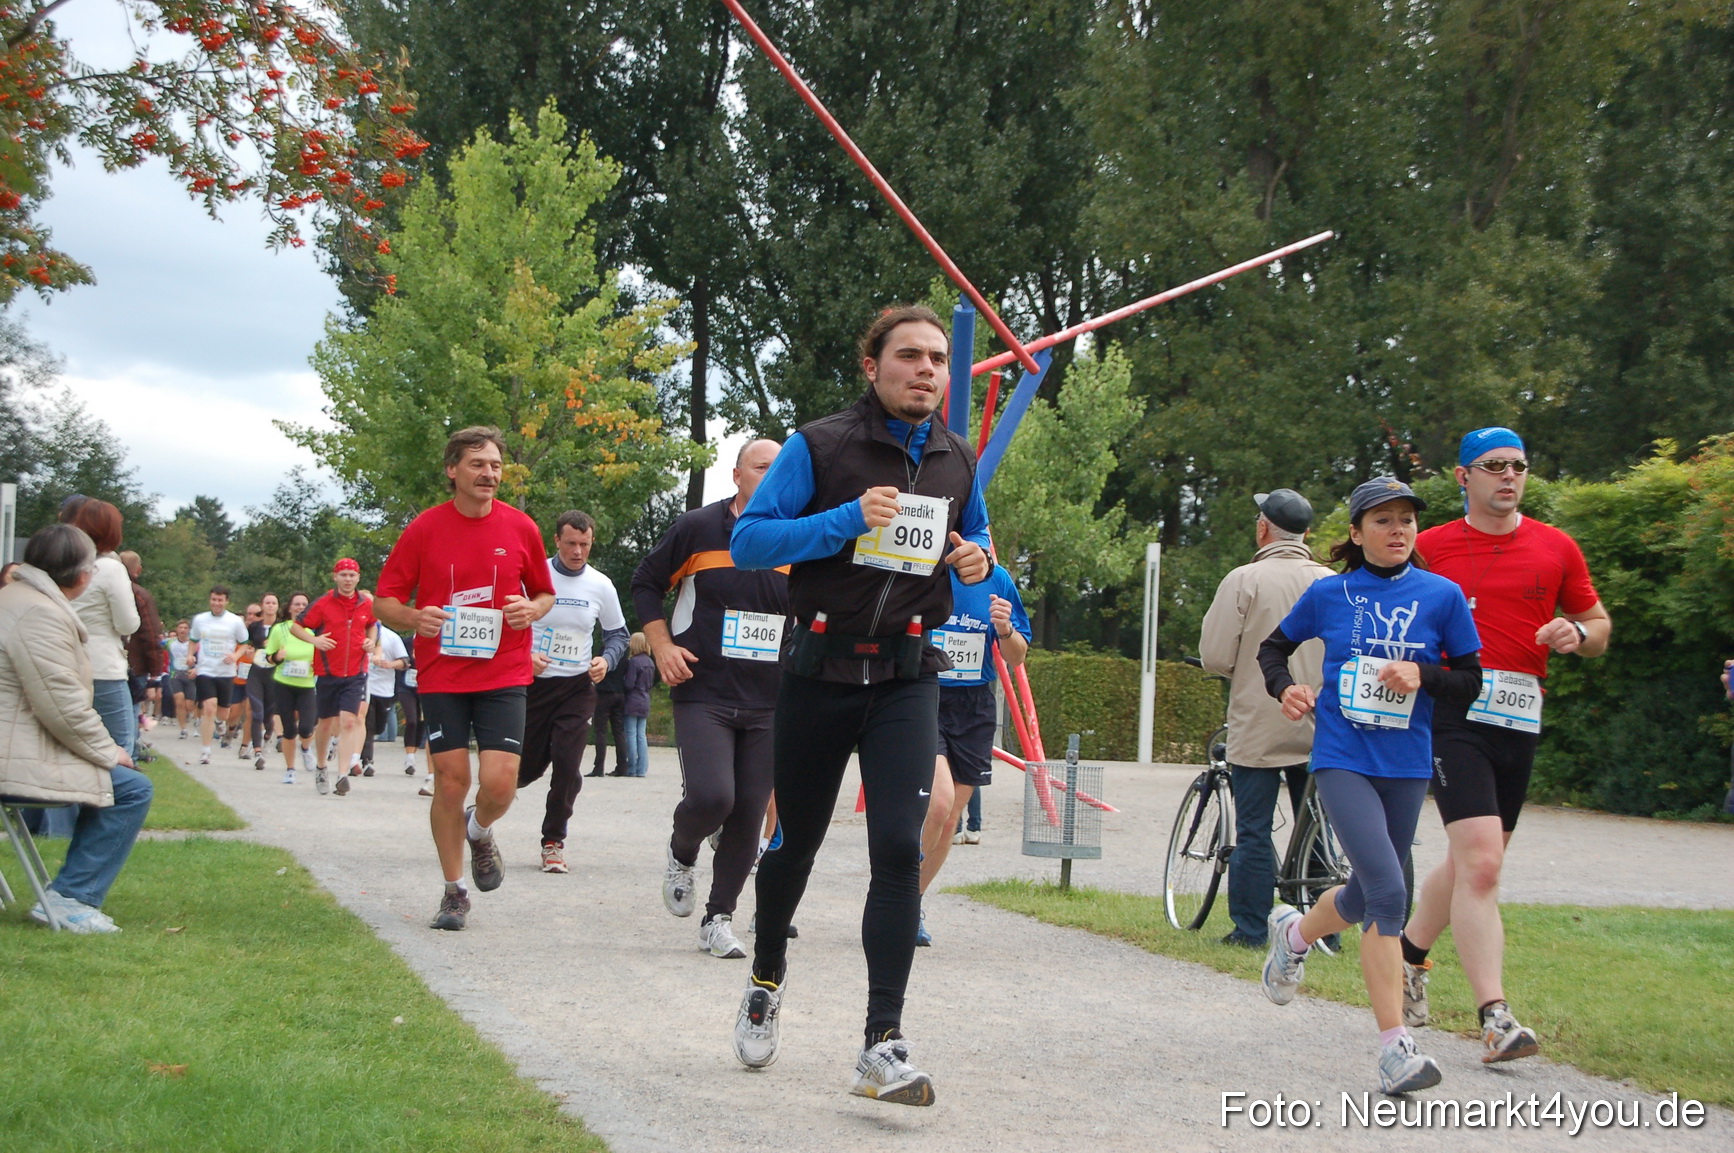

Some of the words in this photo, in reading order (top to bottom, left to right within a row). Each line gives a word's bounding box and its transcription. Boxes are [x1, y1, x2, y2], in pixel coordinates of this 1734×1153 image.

[897, 503, 934, 520] enedikt
[894, 525, 933, 550] 908
[462, 592, 481, 601] DEHN
[460, 611, 494, 624] Wolfgang
[742, 611, 769, 622] Helmut
[459, 625, 495, 641] 2361
[554, 632, 573, 642] Stefan
[742, 625, 776, 642] 3406
[948, 636, 967, 647] Peter
[553, 643, 579, 656] 2111
[948, 650, 978, 663] 2511
[1498, 672, 1534, 688] Sebastian
[1360, 682, 1407, 705] 3409
[1496, 690, 1535, 710] 3067
